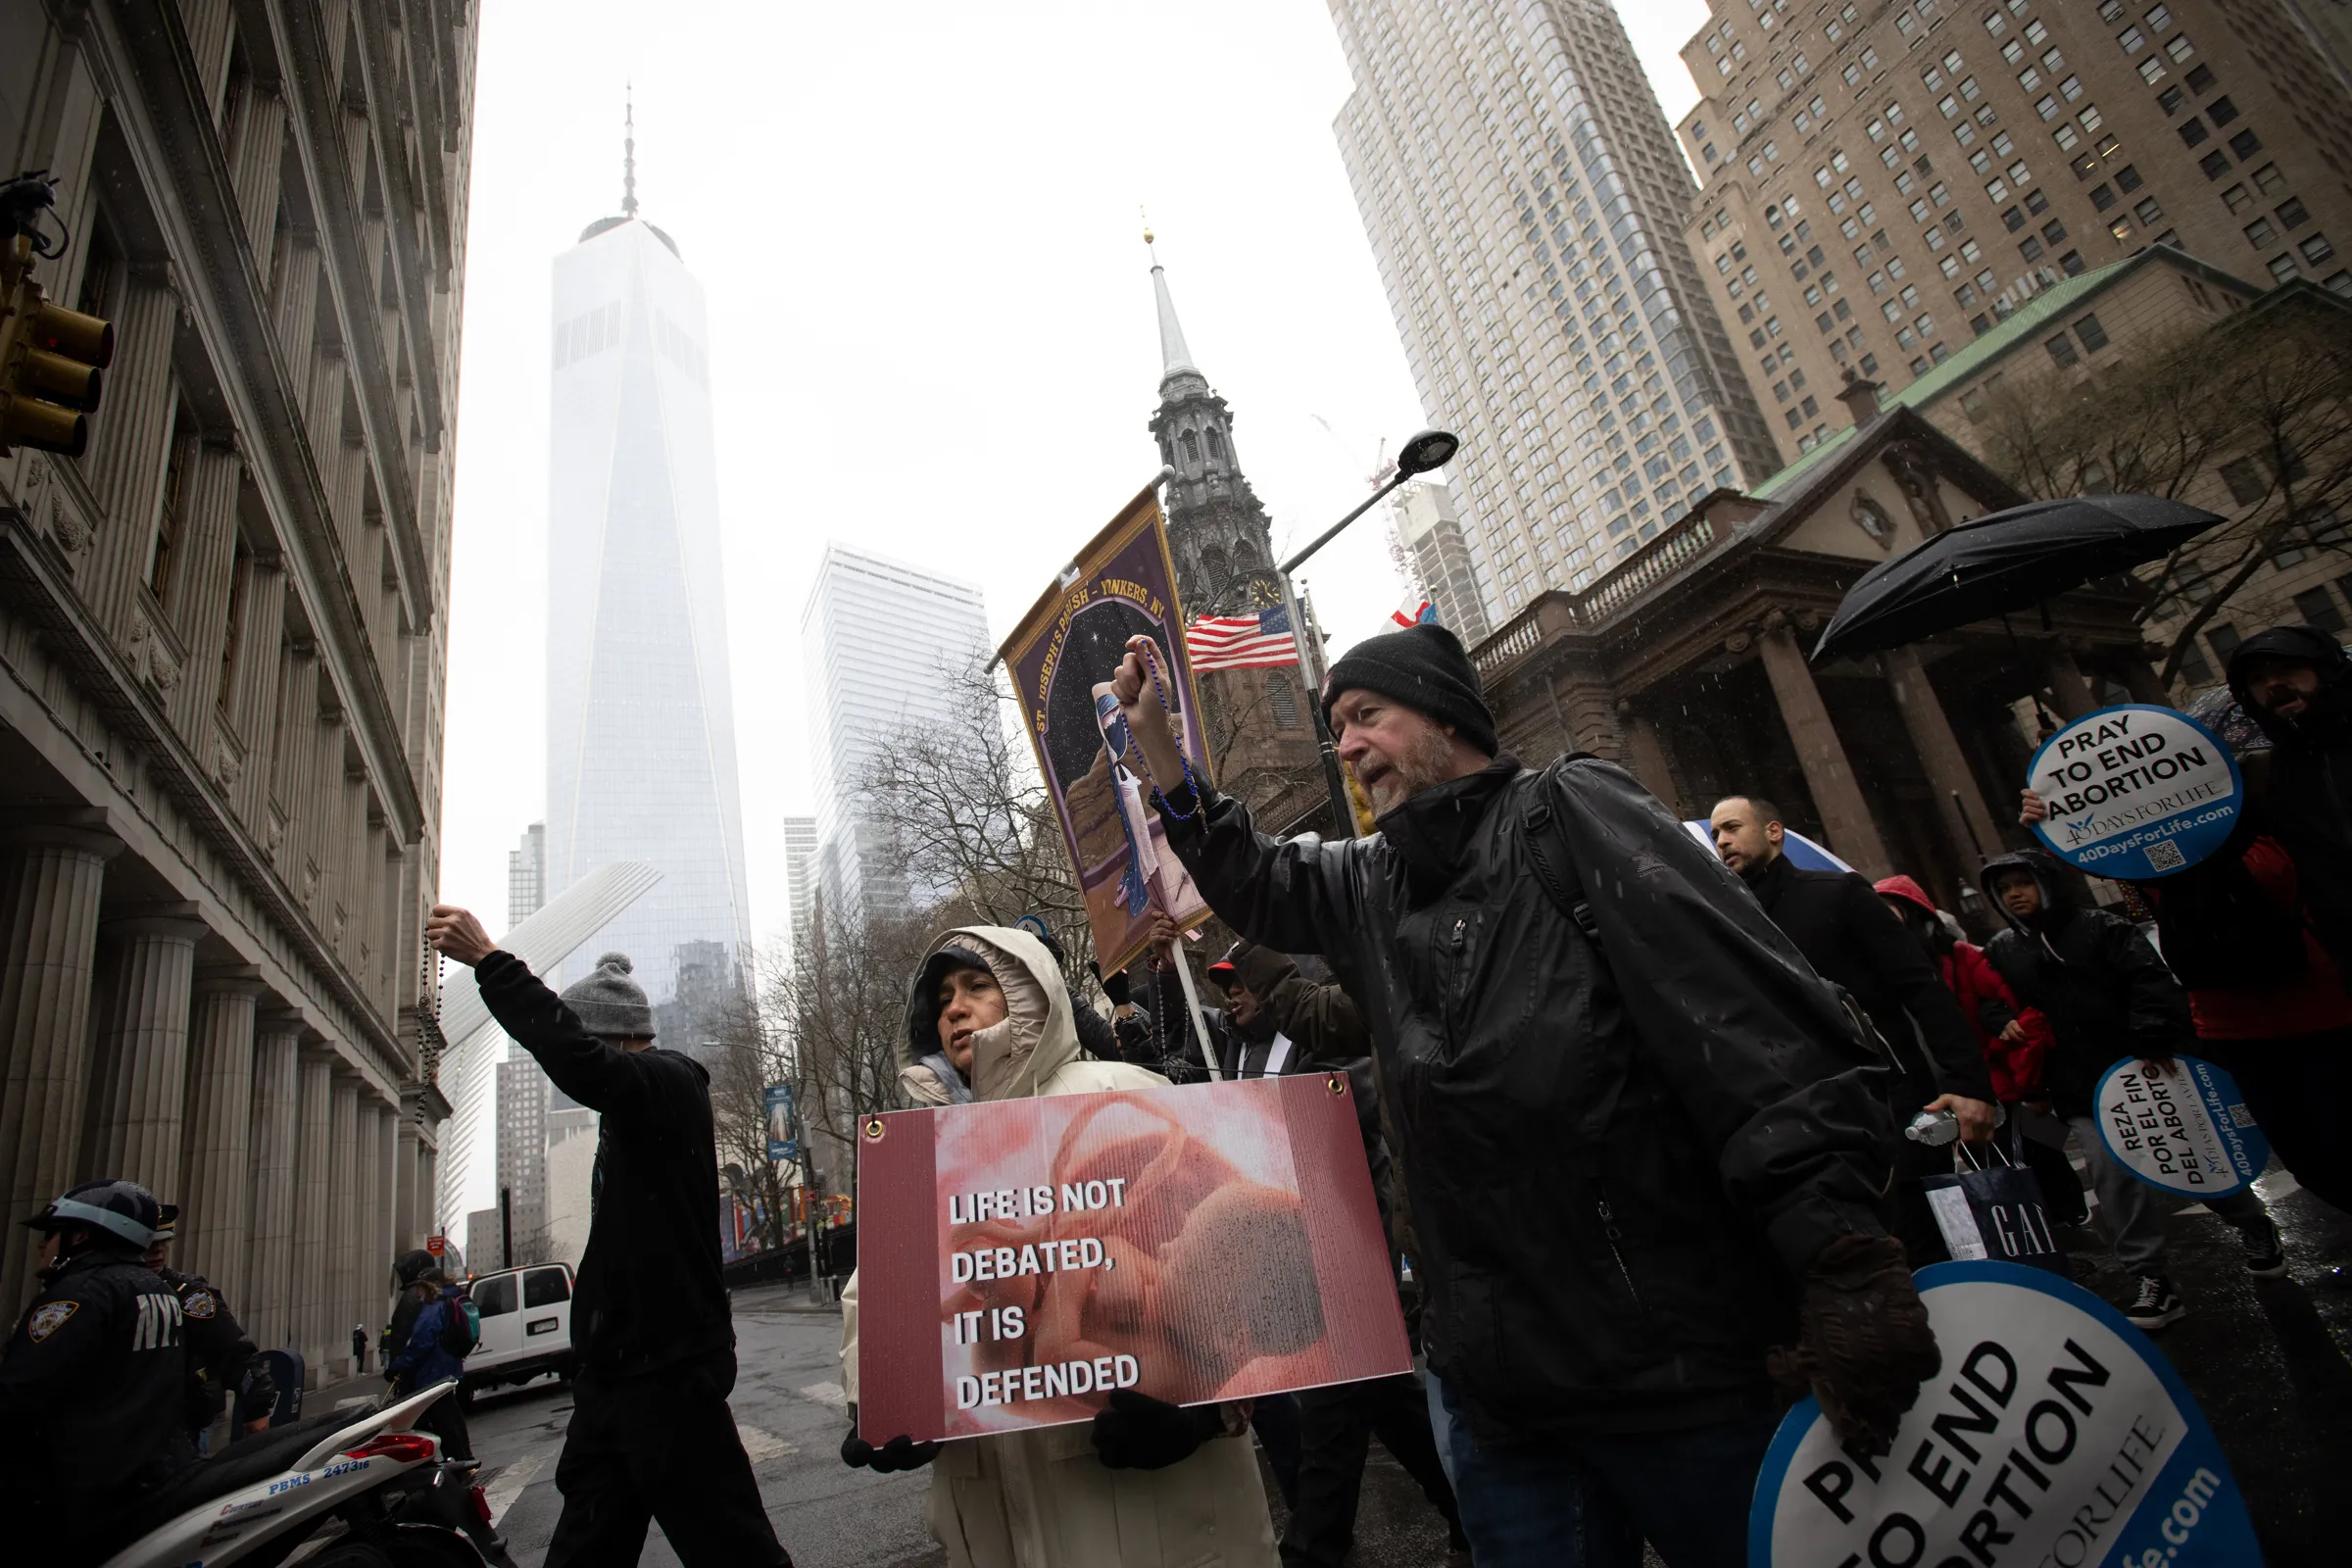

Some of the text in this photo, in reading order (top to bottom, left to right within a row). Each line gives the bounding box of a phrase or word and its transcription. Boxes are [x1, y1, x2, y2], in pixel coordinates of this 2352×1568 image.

[1039, 630, 1063, 702] JOSEPH'S
[1058, 588, 1090, 632] PARISH
[1150, 596, 1165, 619] NY
[2048, 733, 2166, 788] TO END
[2058, 713, 2130, 760] PRAY
[2048, 747, 2207, 821] ABORTION
[2066, 780, 2223, 846] 40 DAYS FOR LIFE
[2078, 805, 2234, 863] 40DaysForLife.com
[2111, 1102, 2143, 1151] REZA
[2120, 1074, 2179, 1174] POR EL FIN
[2141, 1066, 2204, 1184] DEL ABORTO
[2195, 1063, 2253, 1176] 40DaysForLife.com
[950, 1178, 1127, 1225] LIFE IS NOT
[952, 1238, 1115, 1283] DEBATED,
[132, 1294, 183, 1352] NYP
[954, 1306, 1025, 1346] IT IS
[956, 1354, 1140, 1410] DEFENDED
[1907, 1341, 2018, 1508] END
[269, 1473, 311, 1495] PBMS
[2092, 1414, 2165, 1509] LIFE
